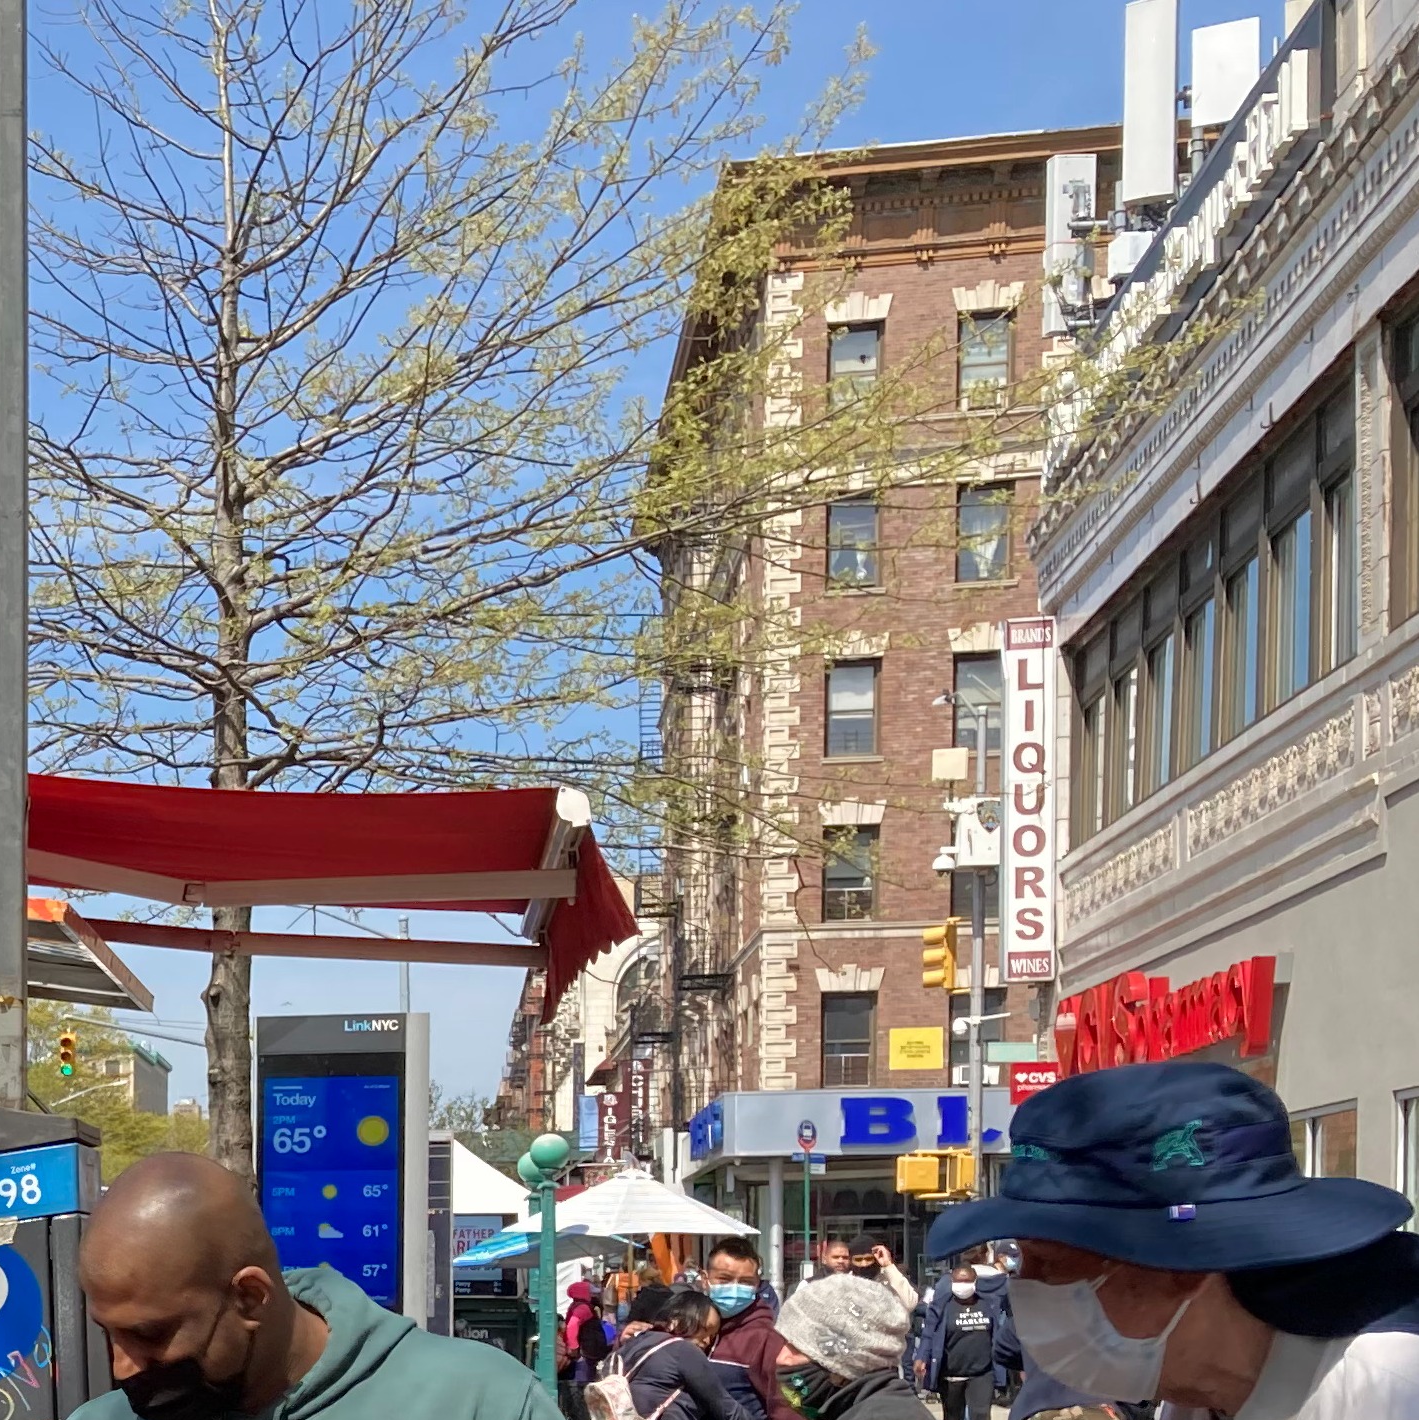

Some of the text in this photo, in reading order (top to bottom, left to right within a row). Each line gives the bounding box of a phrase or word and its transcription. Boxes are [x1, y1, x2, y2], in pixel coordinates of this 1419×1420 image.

[1011, 626, 1052, 645] BRANDS
[1012, 658, 1046, 941] LIQUORS
[1010, 957, 1049, 974] WINES
[344, 1019, 399, 1032] LinkNYC
[1028, 1071, 1056, 1084] CVS
[272, 1092, 317, 1108] Today
[272, 1115, 296, 1125] 2PM
[272, 1125, 327, 1154] 65°
[10, 1163, 37, 1175] Zone#
[362, 1184, 389, 1198] 65°
[362, 1223, 389, 1237] 61°
[362, 1263, 388, 1278] 57°
